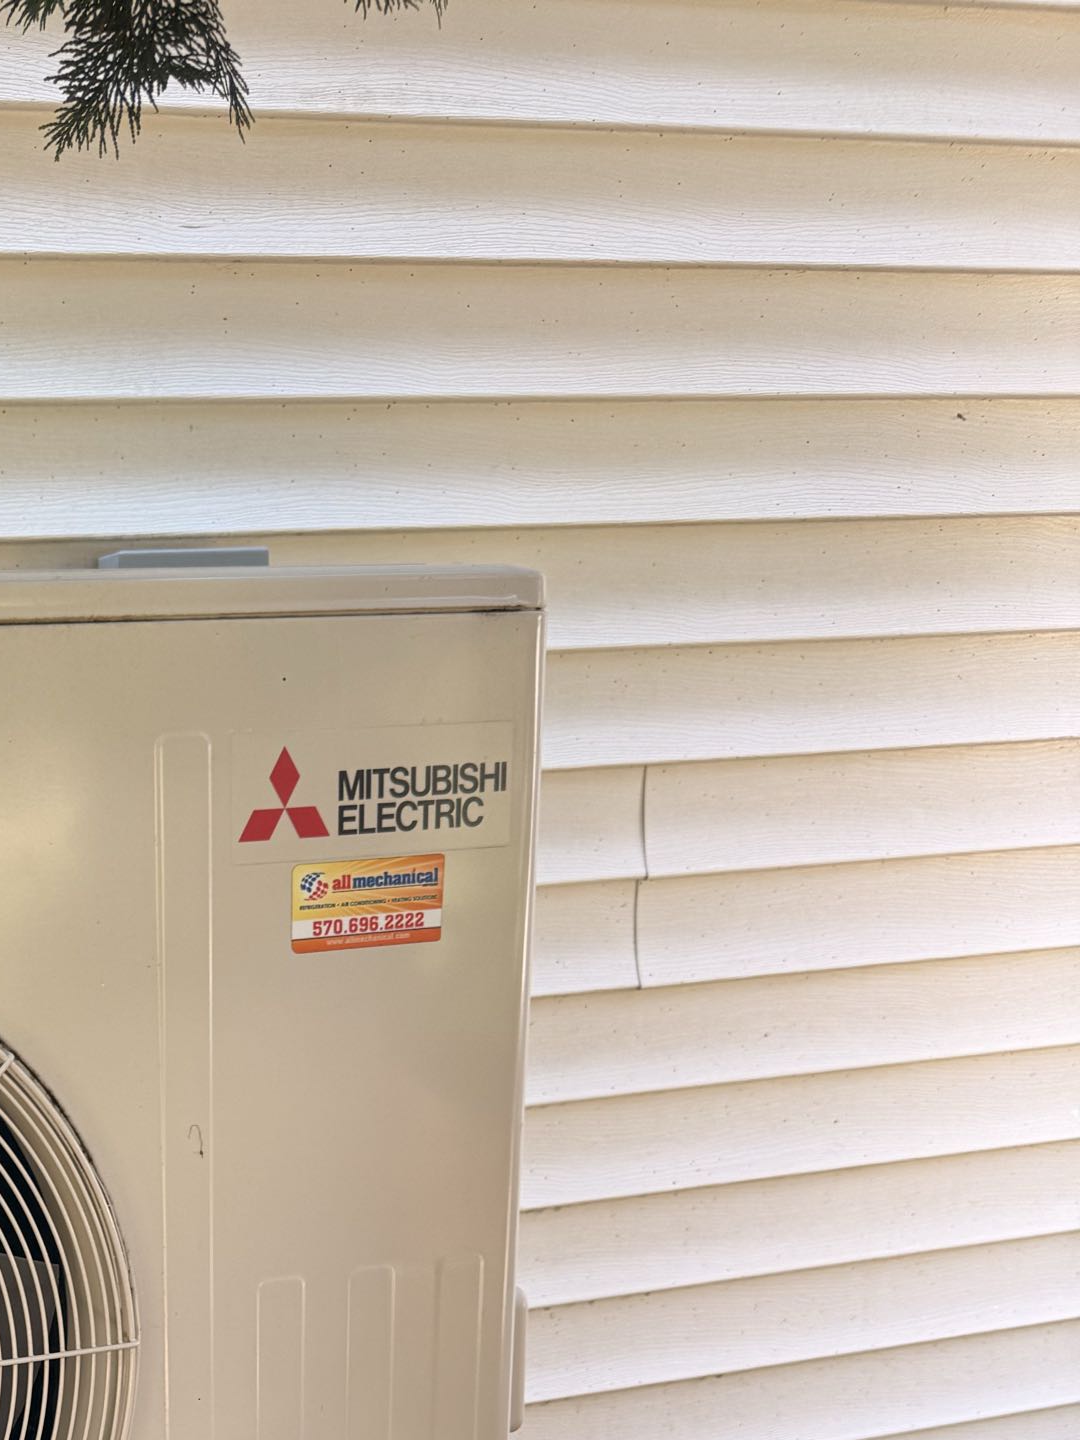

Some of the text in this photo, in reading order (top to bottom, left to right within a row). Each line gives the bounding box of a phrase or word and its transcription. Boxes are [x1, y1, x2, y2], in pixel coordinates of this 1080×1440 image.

[338, 761, 507, 801] MITSUBISHI
[338, 796, 484, 836] ELECTRIC
[313, 912, 424, 936] 570.696.2222
